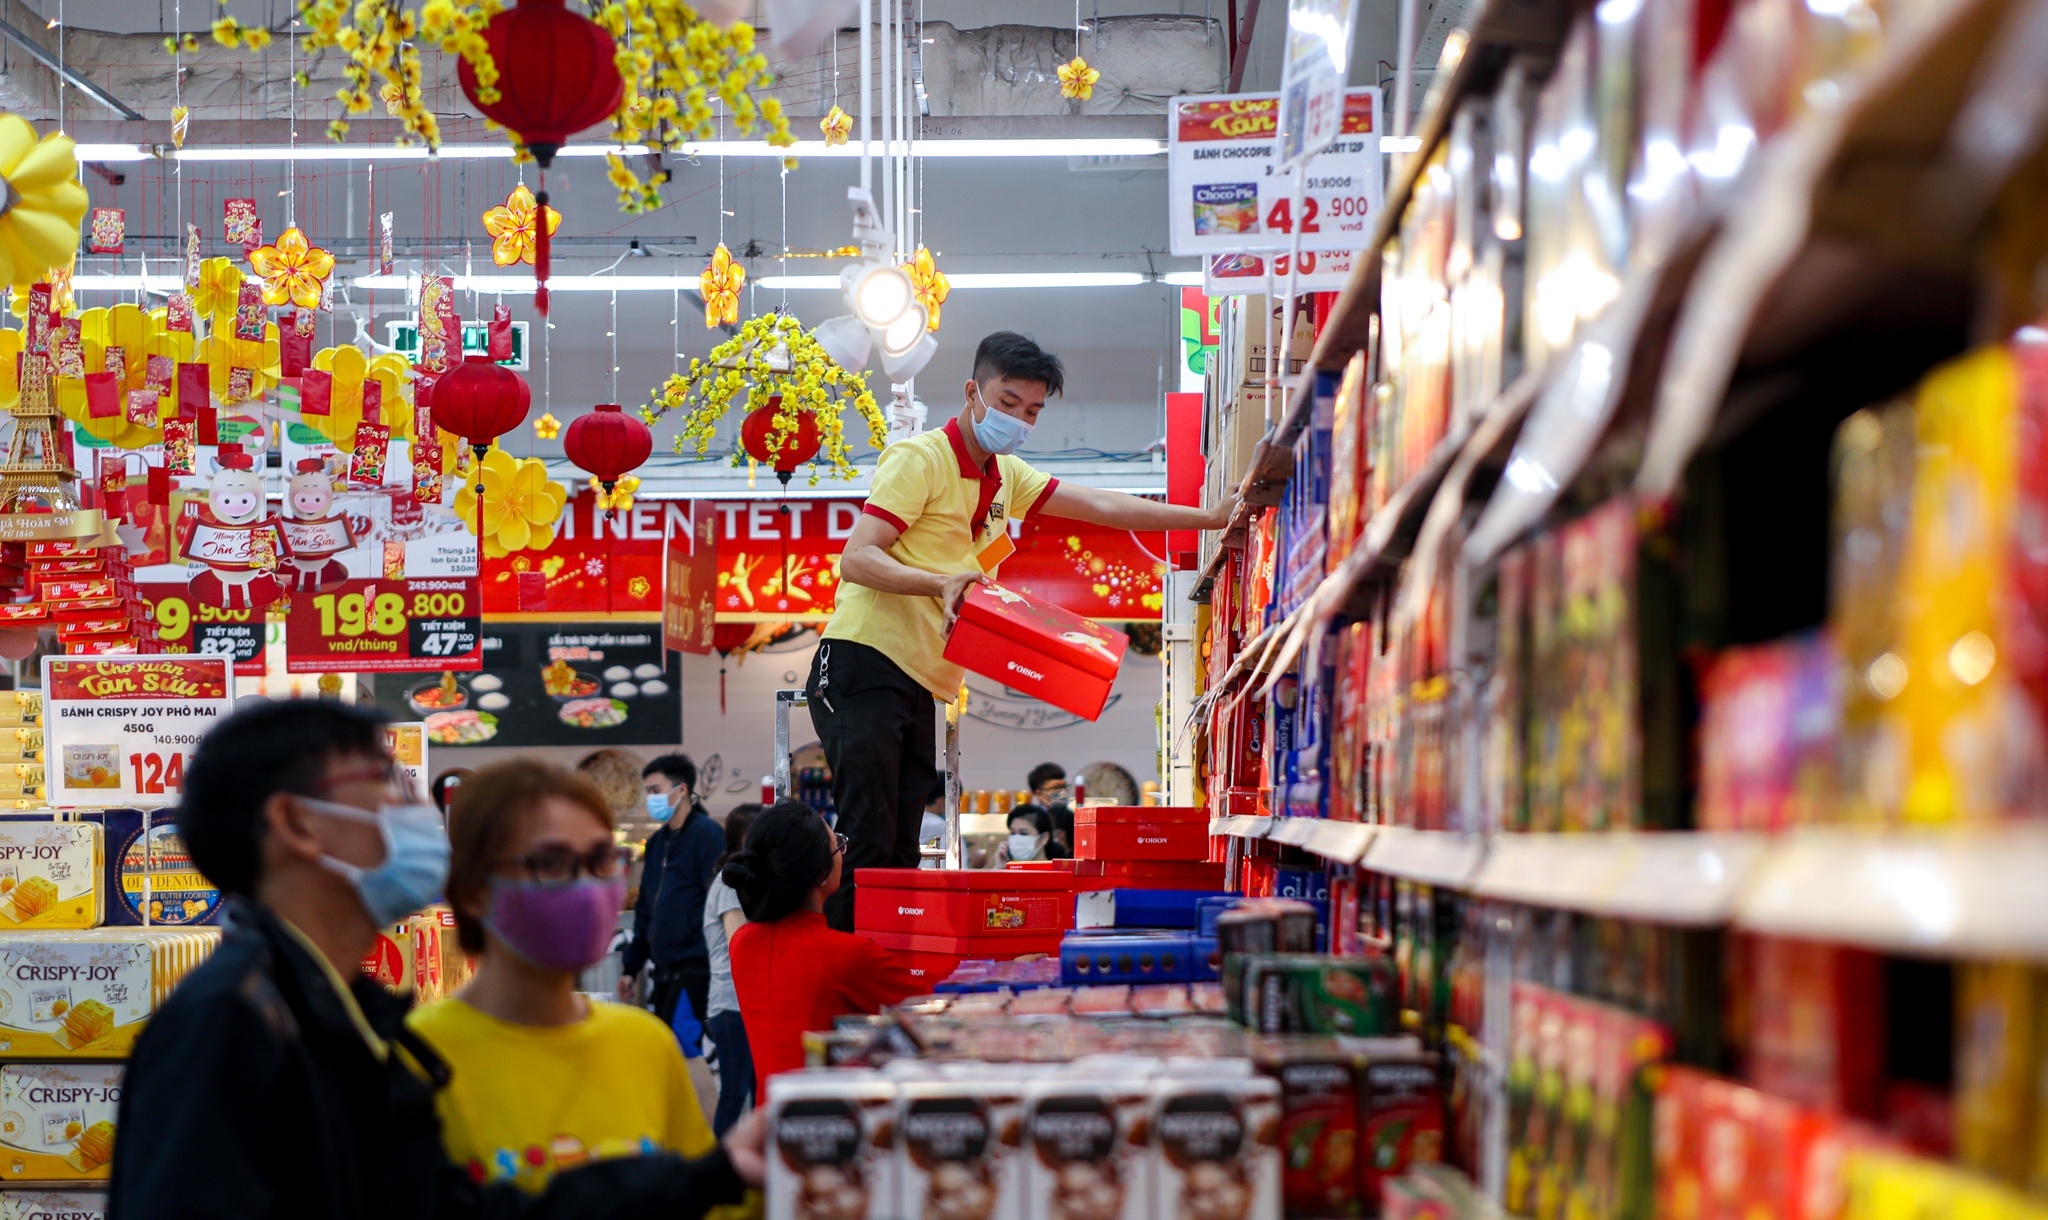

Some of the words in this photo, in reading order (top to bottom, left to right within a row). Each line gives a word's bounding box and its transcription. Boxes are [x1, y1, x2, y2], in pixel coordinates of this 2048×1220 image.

[1193, 147, 1221, 160] BÁNH
[1223, 146, 1272, 159] CHOCOPIE
[1326, 195, 1368, 217] .900
[313, 592, 407, 637] 198
[407, 592, 465, 616] .800
[421, 632, 458, 655] 47
[137, 660, 184, 677] xuân
[1015, 664, 1045, 682] ORION
[78, 674, 138, 697] Tân
[61, 705, 95, 718] BÁNH
[97, 707, 138, 718] CRISPY
[141, 707, 163, 718] JOY
[166, 705, 192, 717] PHÔ
[194, 706, 217, 717] MAI
[123, 723, 155, 734] 450G
[183, 890, 211, 899] COOKIES
[905, 907, 925, 916] ORION
[16, 965, 120, 981] CRISPY-JOY
